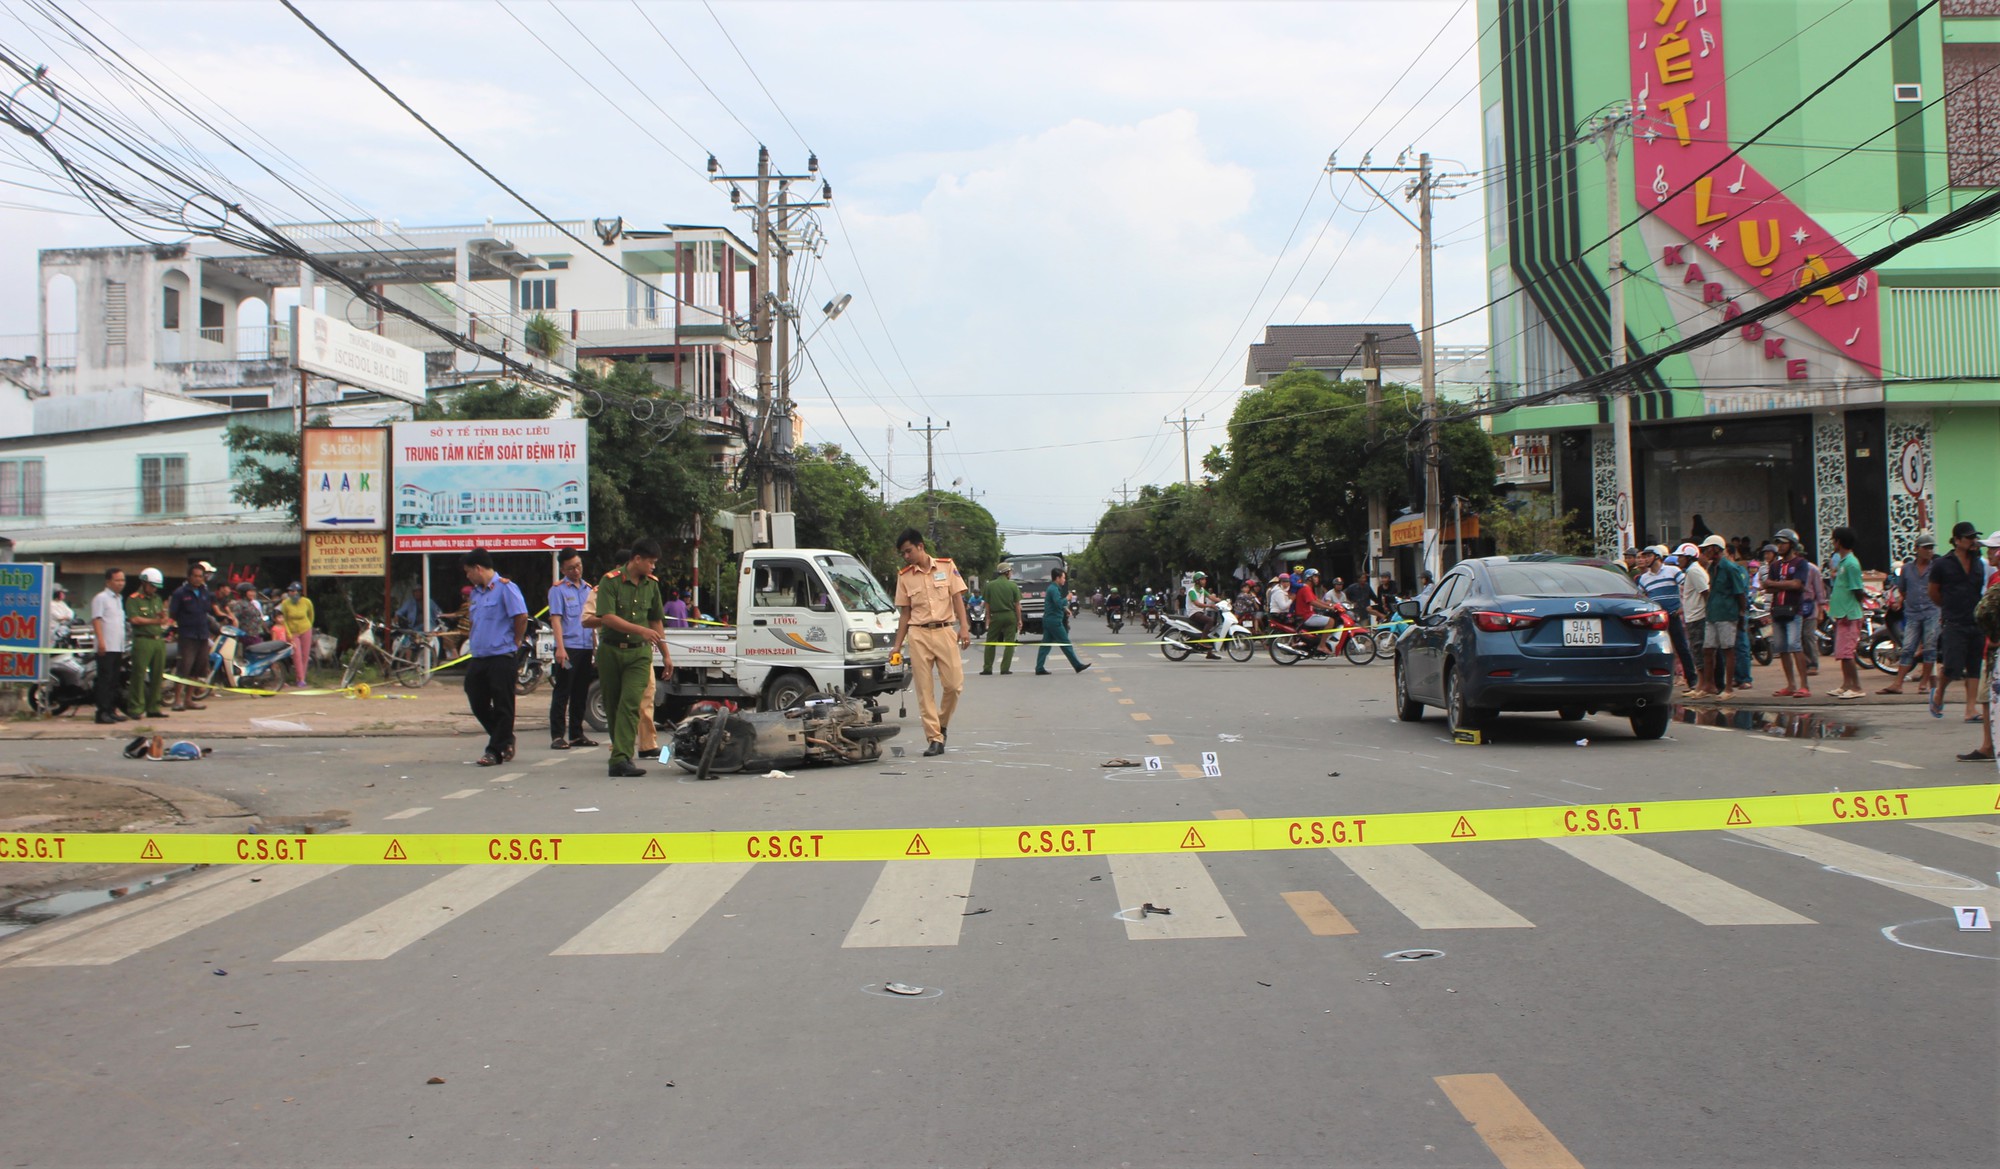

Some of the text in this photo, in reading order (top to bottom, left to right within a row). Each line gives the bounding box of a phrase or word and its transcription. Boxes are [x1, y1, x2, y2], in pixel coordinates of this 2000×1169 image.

[1663, 243, 1809, 381] KARAOKE
[447, 429, 454, 437] Y
[457, 425, 471, 437] TẾ
[502, 427, 523, 437] BẠC
[526, 426, 550, 436] LIÊU
[320, 443, 372, 456] SAIGON
[405, 439, 577, 462] TRUNG TÂM KIỂM SOÁT BỆNH TẬT
[348, 547, 378, 555] QUANG
[350, 535, 379, 544] CHAY
[0, 567, 34, 590] hip
[0, 610, 37, 639] ƠM
[1572, 620, 1592, 632] 94A
[1149, 758, 1159, 769] 6
[1206, 753, 1215, 765] 9
[1206, 765, 1219, 776] 10
[1833, 793, 1908, 818] C.S.G.T
[1564, 807, 1641, 832] C.S.G.T
[1018, 829, 1096, 854] C.S.G.T
[1289, 819, 1366, 845] C.S.G.T
[237, 838, 307, 861] C.S.G.T
[488, 838, 562, 861] C.S.G.T
[747, 834, 824, 859] C.S.G.T
[1962, 908, 1979, 927] 7
